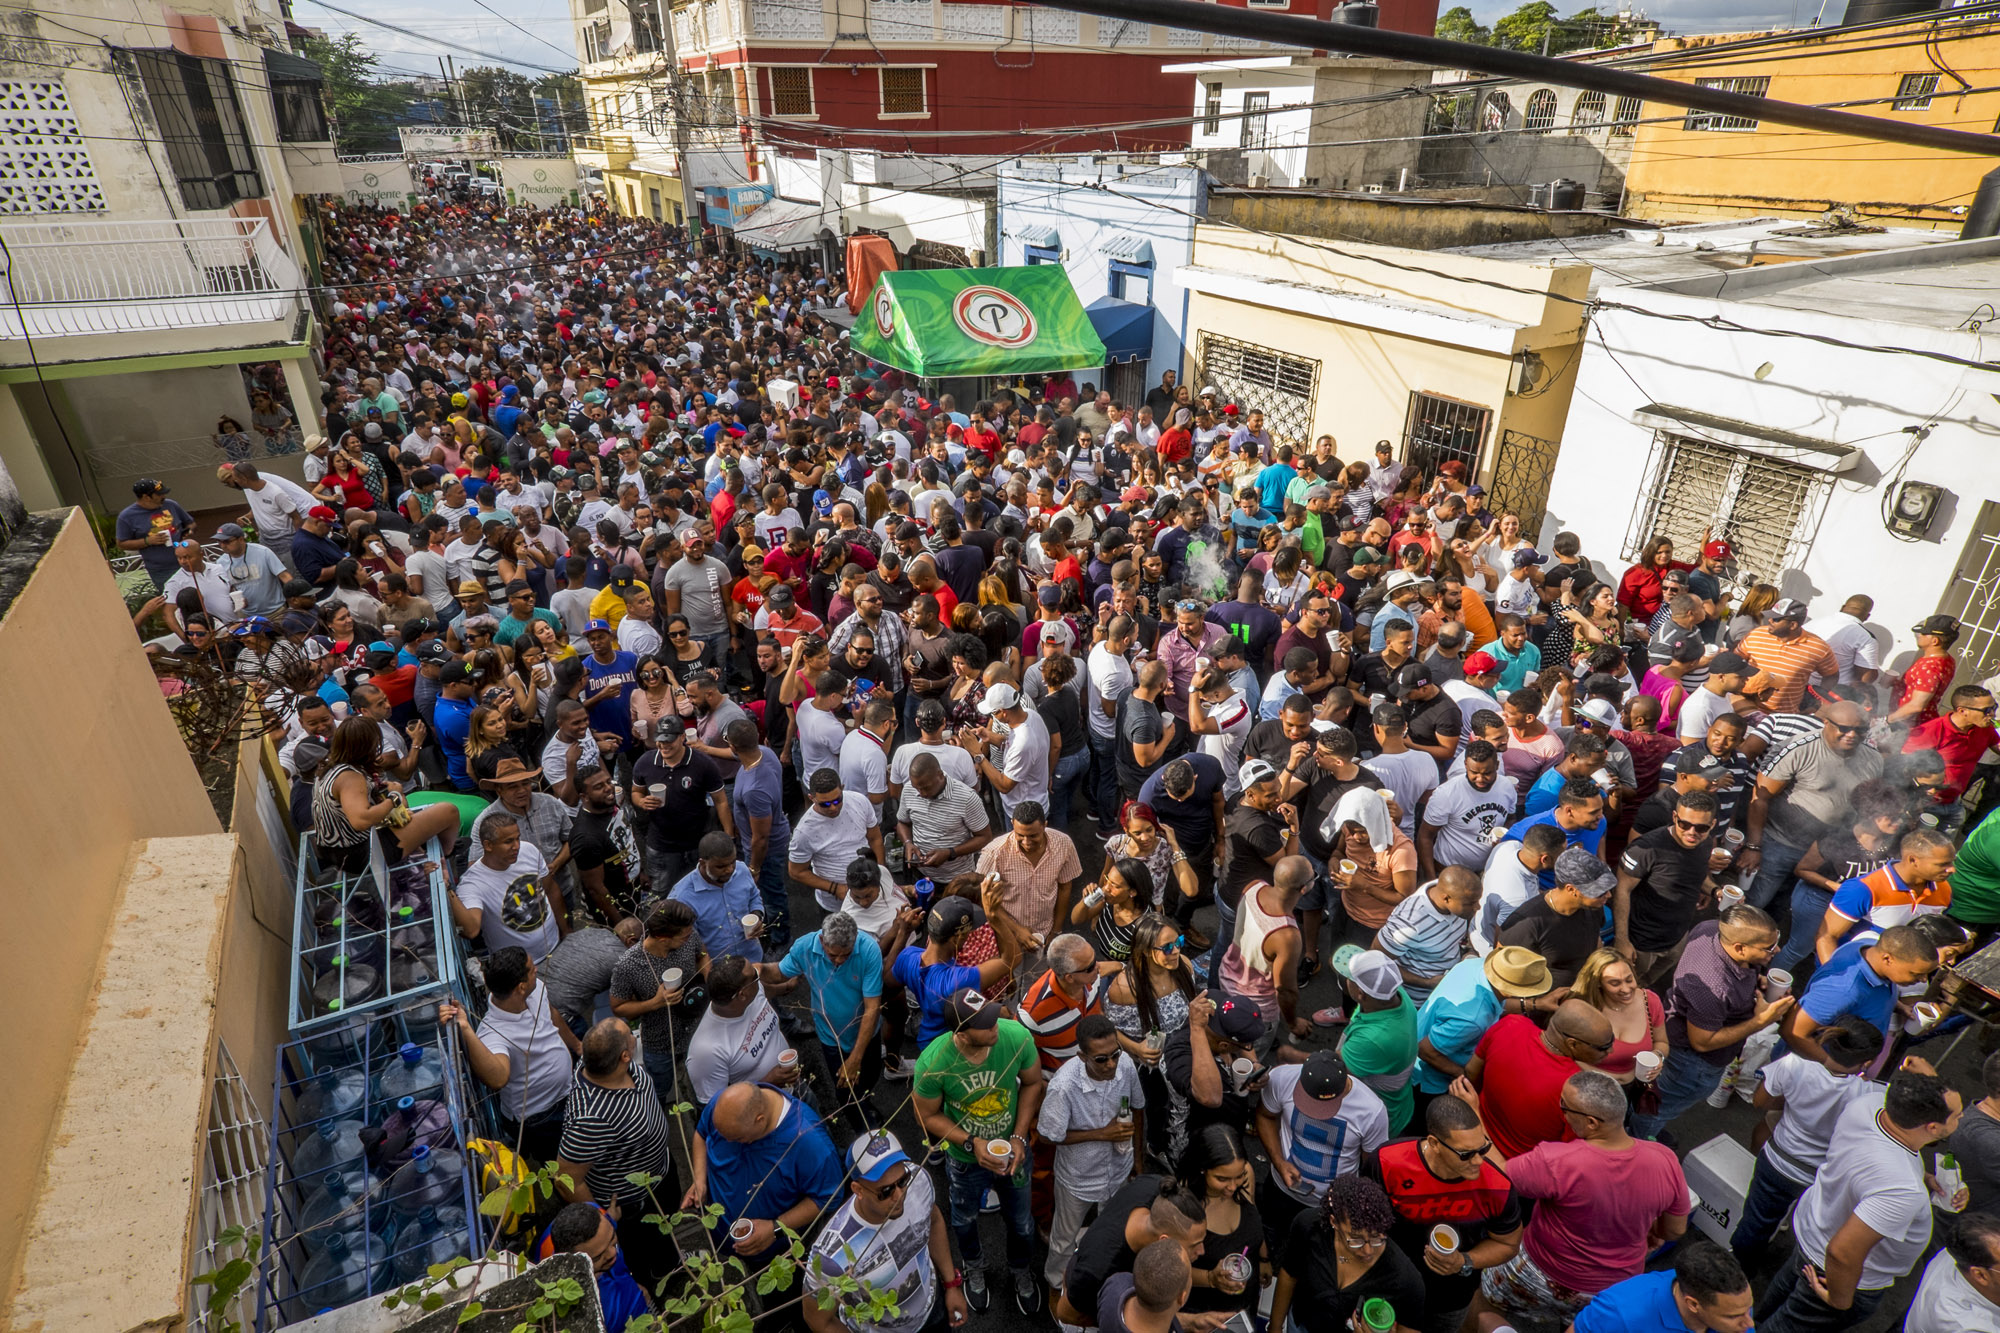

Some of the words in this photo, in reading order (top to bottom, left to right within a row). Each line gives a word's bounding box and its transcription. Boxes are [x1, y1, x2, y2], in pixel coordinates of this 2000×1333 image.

[348, 189, 401, 202] Presidente
[519, 183, 566, 195] Presidente
[738, 191, 764, 202] BANCA
[978, 303, 1009, 333] P
[1716, 545, 1726, 554] T
[706, 567, 721, 616] HOLLSTER
[1230, 623, 1251, 645] 11
[687, 660, 703, 671] TEAM
[961, 1070, 997, 1094] LEVI
